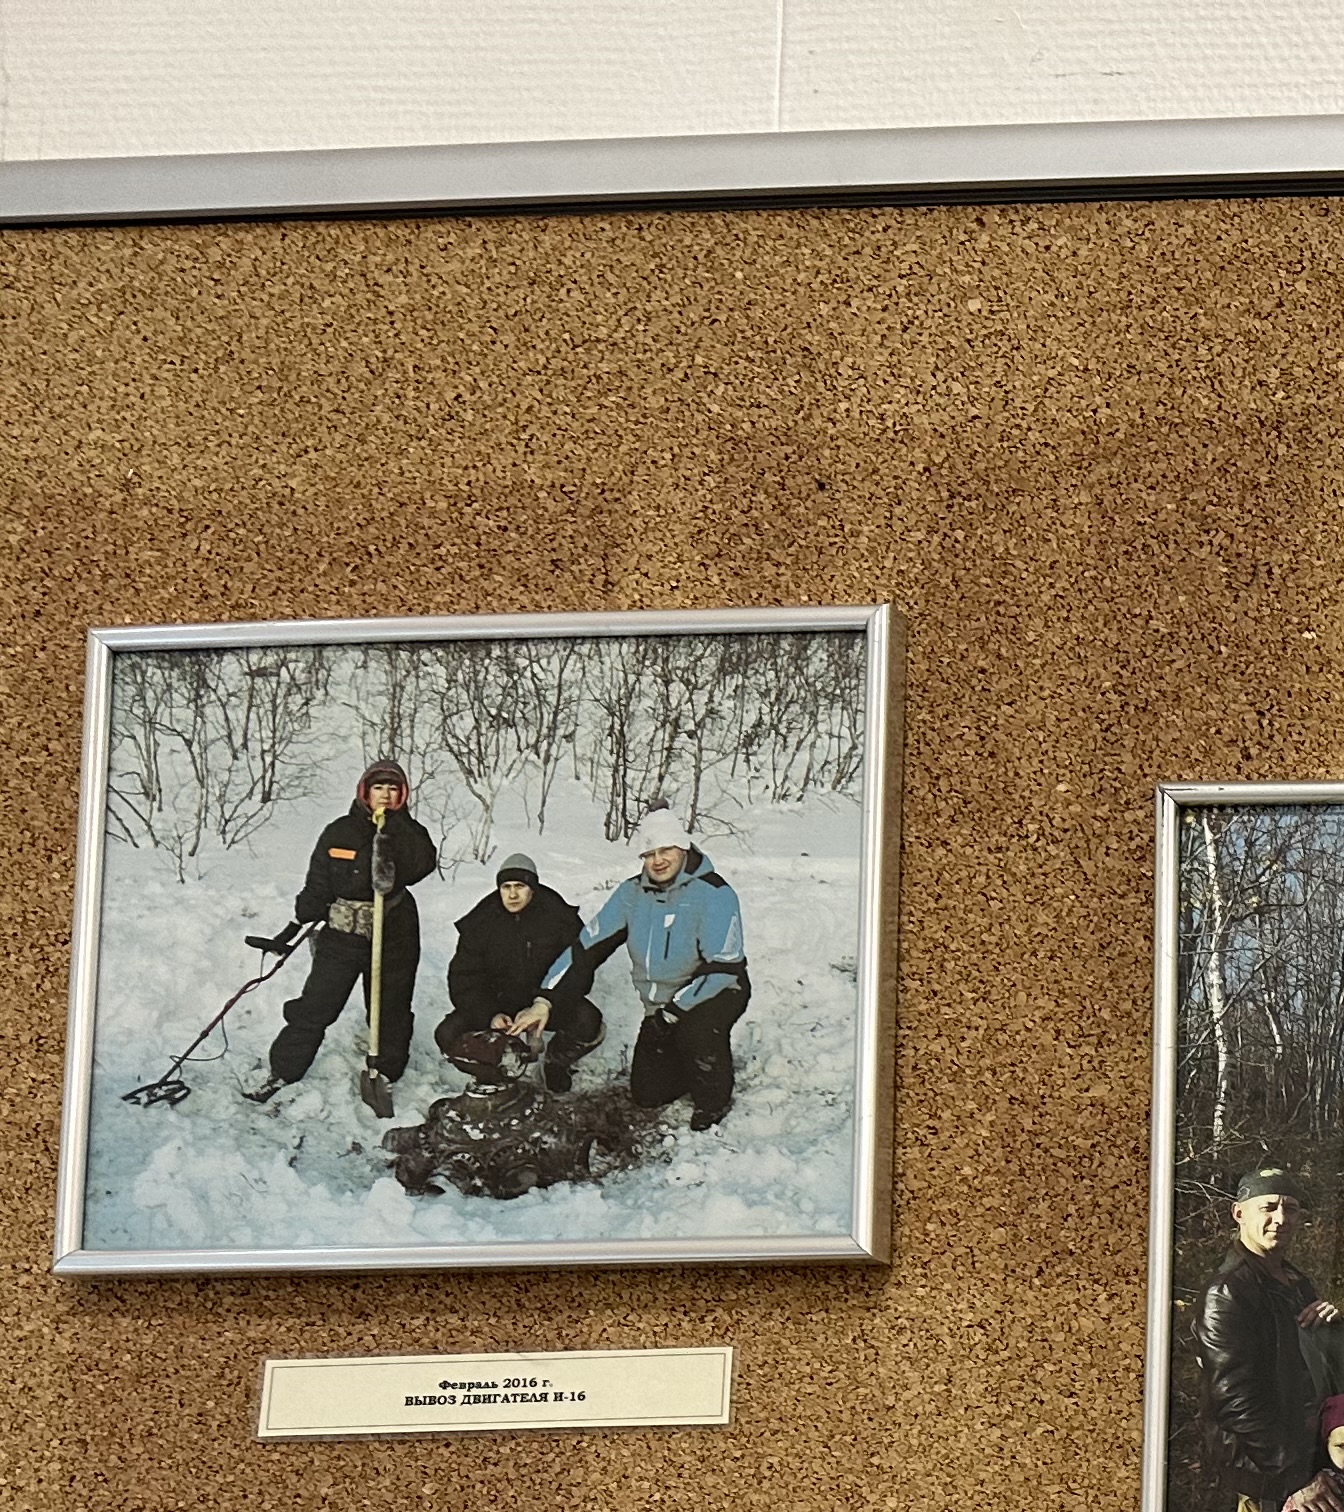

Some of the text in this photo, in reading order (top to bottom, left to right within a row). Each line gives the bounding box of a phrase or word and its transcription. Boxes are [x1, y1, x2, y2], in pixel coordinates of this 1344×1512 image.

[437, 1376, 554, 1392] Февраль 2016 г.
[403, 1389, 587, 1407] ВЫВОЗ ДВИГАТЕЛЯ И-16
